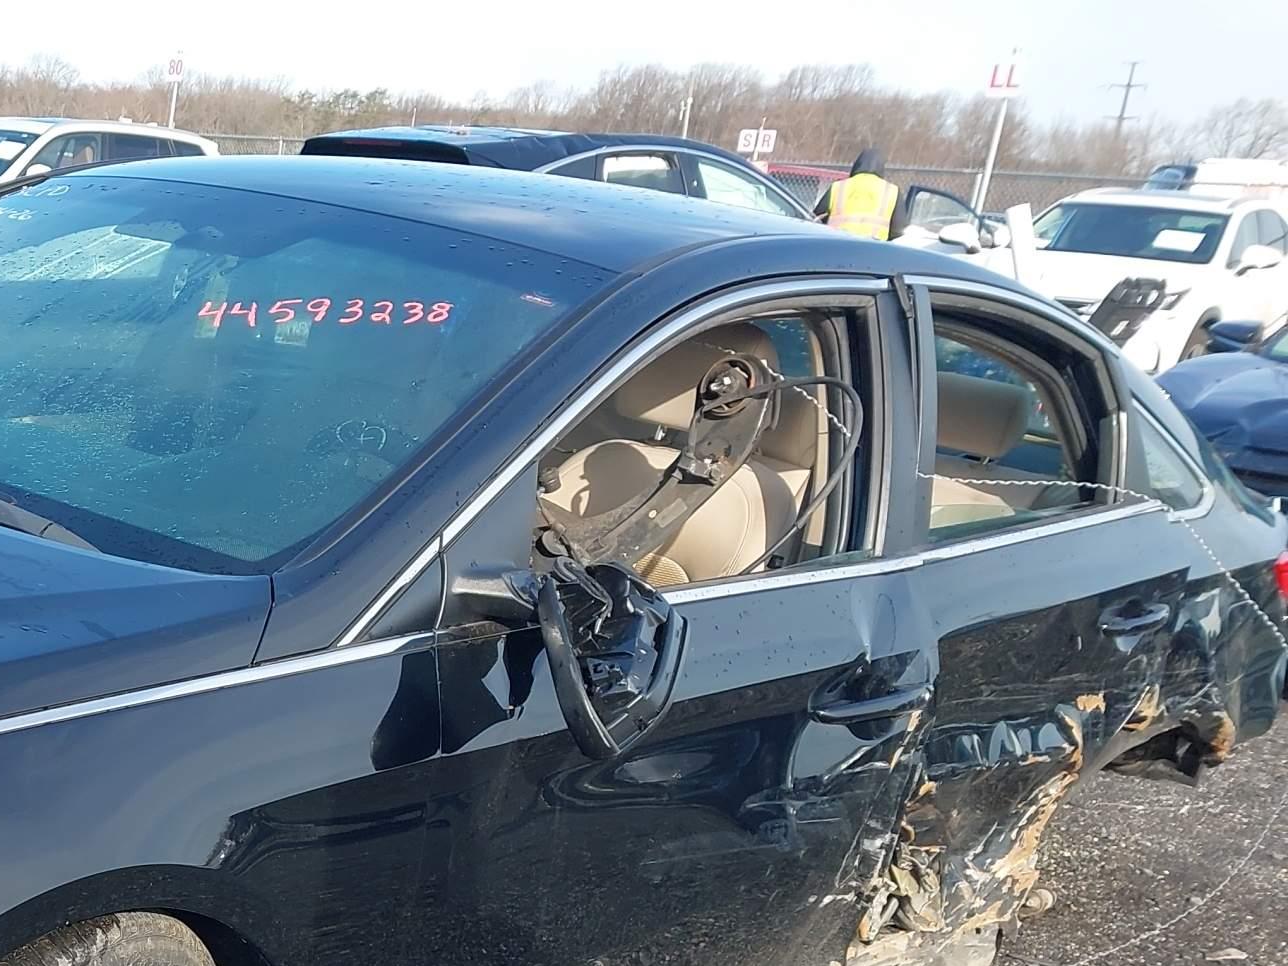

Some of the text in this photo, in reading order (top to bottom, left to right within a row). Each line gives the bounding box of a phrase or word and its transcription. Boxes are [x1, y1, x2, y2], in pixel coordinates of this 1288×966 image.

[169, 59, 183, 75] 80
[990, 64, 1020, 88] LL
[743, 133, 753, 148] S
[762, 133, 771, 148] R
[197, 298, 454, 328] 44593238
